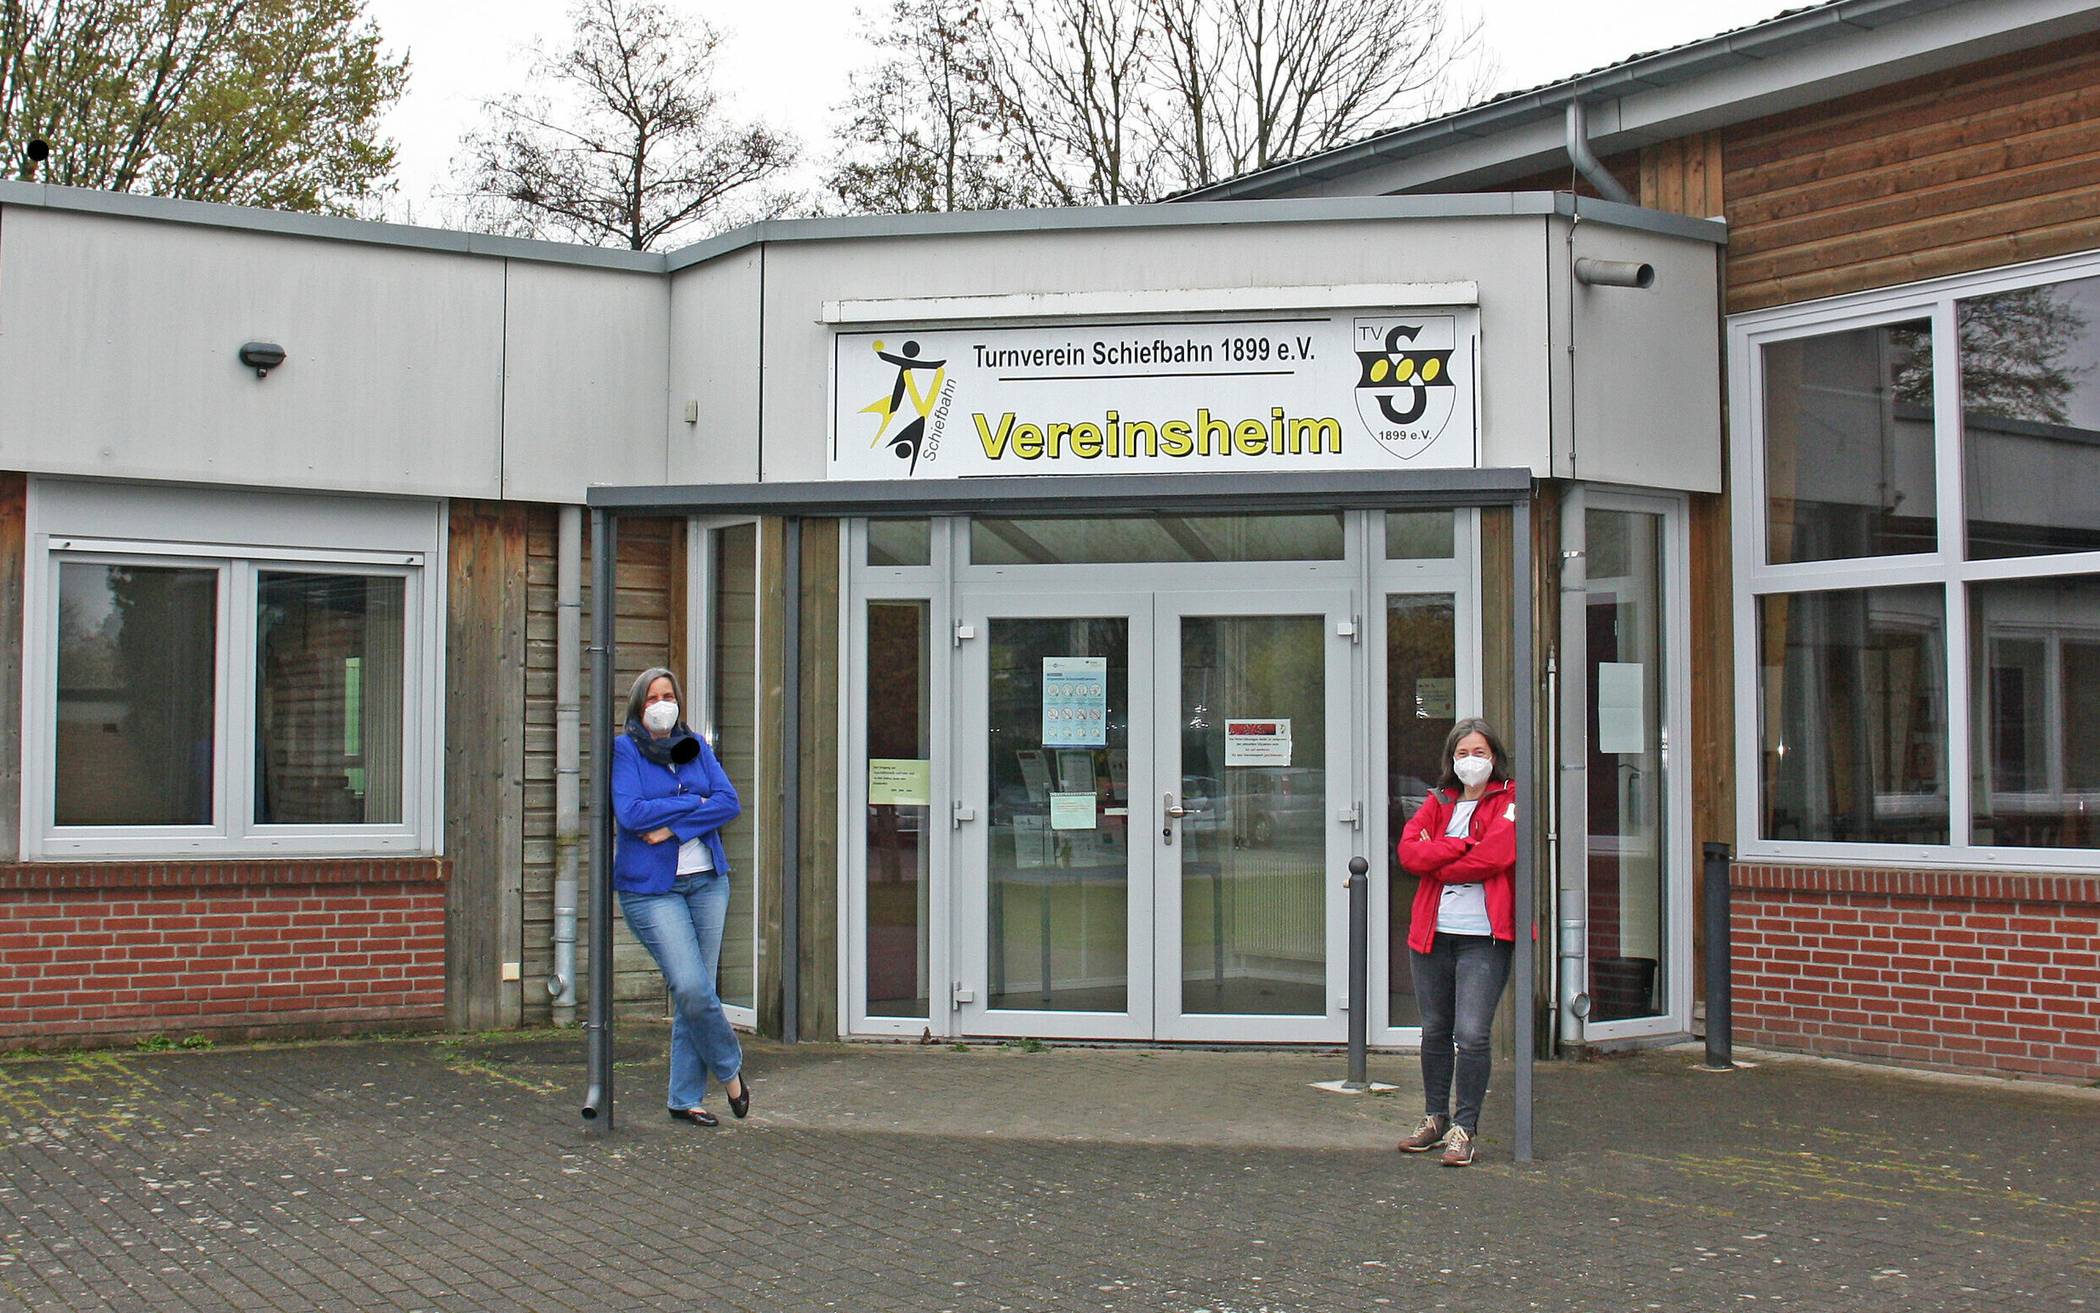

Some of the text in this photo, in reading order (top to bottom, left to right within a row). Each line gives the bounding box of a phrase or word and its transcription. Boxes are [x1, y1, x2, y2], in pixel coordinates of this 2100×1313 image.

[1358, 325, 1384, 341] TV
[973, 336, 1315, 368] Turnverein Schiefbahn 1899 e.V.
[922, 378, 957, 462] Schiefbahn
[971, 406, 1342, 460] Vereinsheim
[1378, 430, 1432, 440] 1899 e.V.
